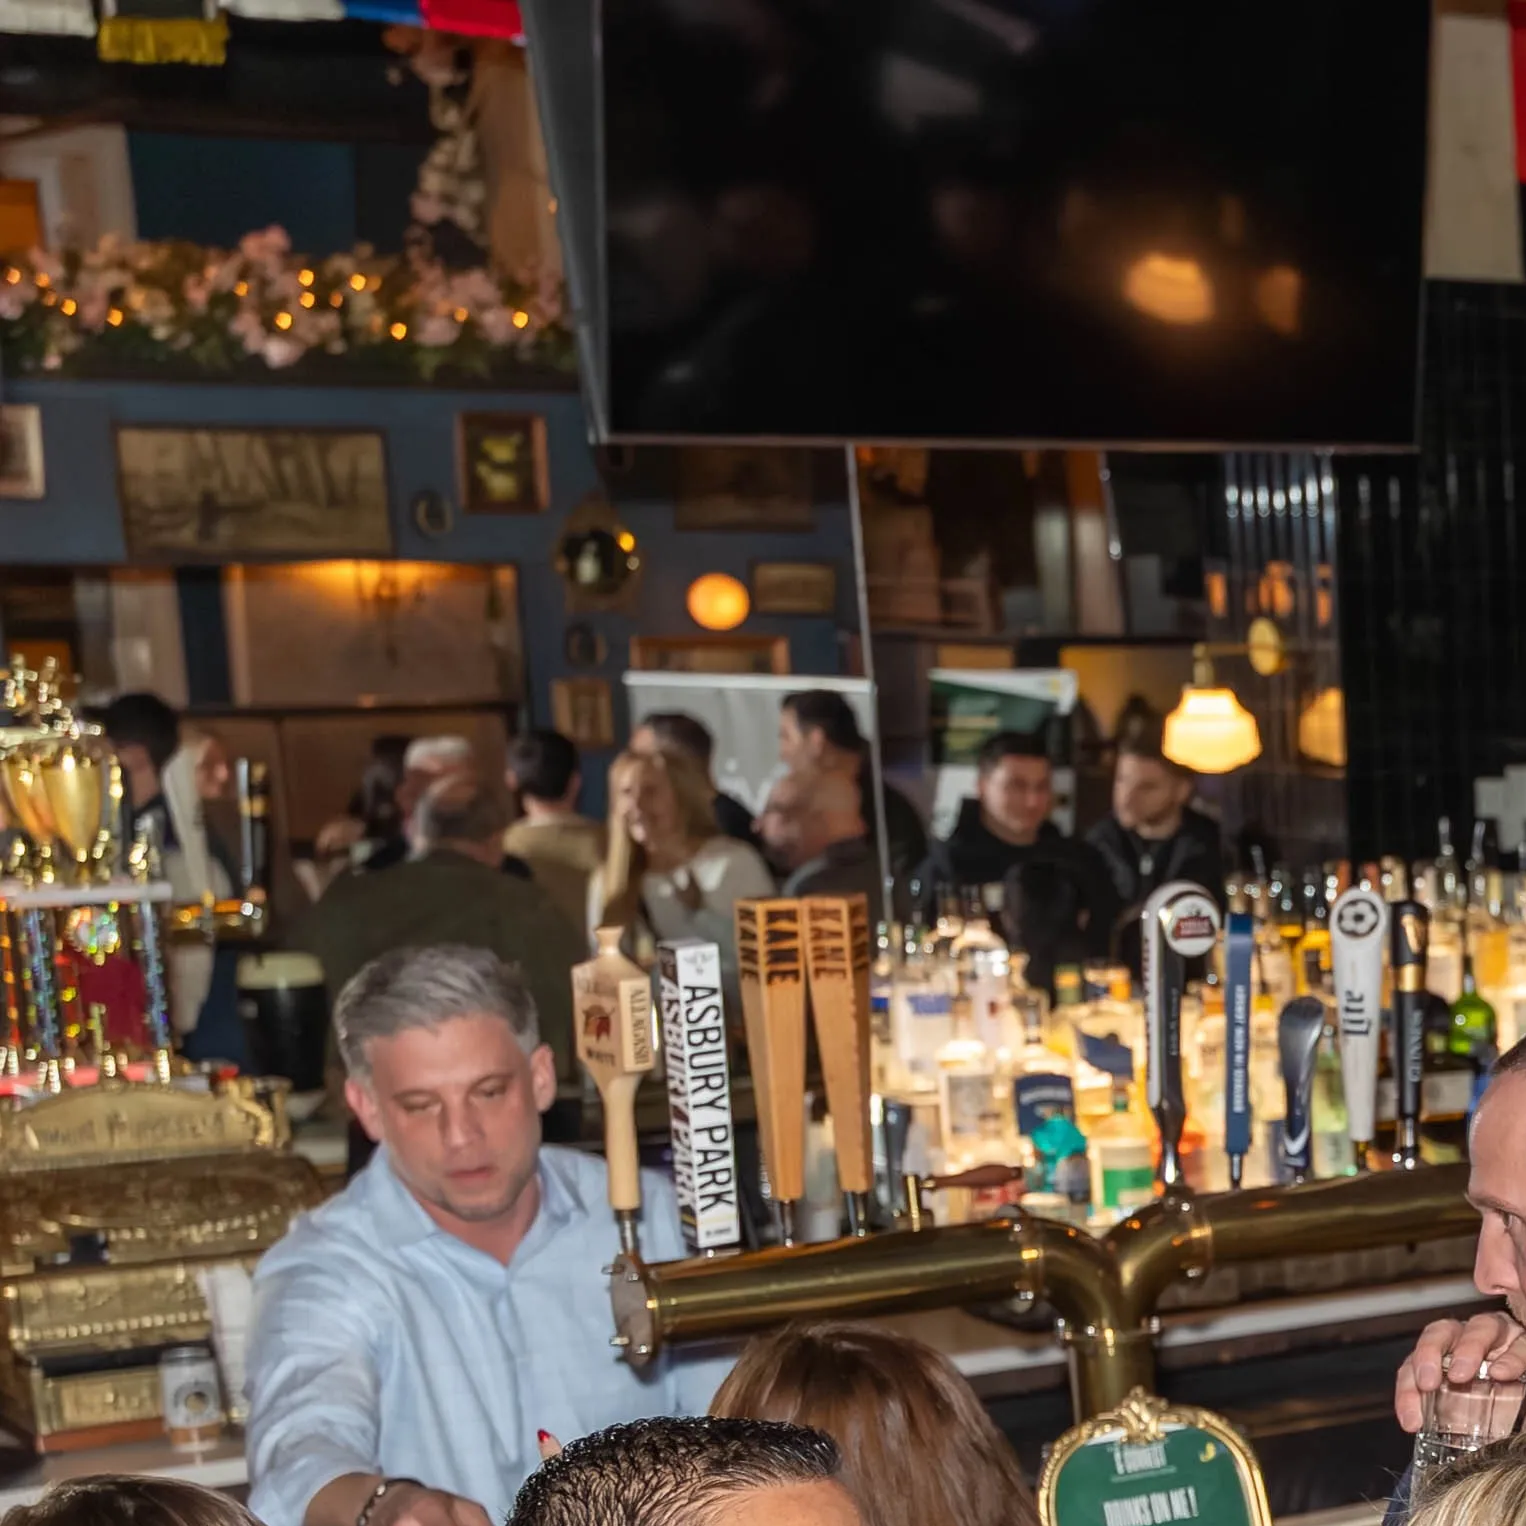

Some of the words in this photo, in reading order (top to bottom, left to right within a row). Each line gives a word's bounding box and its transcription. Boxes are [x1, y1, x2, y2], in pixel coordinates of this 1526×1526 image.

[766, 909, 800, 985] KANE
[809, 907, 847, 980] KANE
[660, 975, 689, 1114] ASBURY
[683, 984, 728, 1113] ASBURY
[1343, 990, 1371, 1036] Lite
[672, 1118, 697, 1208] PARK
[693, 1123, 736, 1213] PARK
